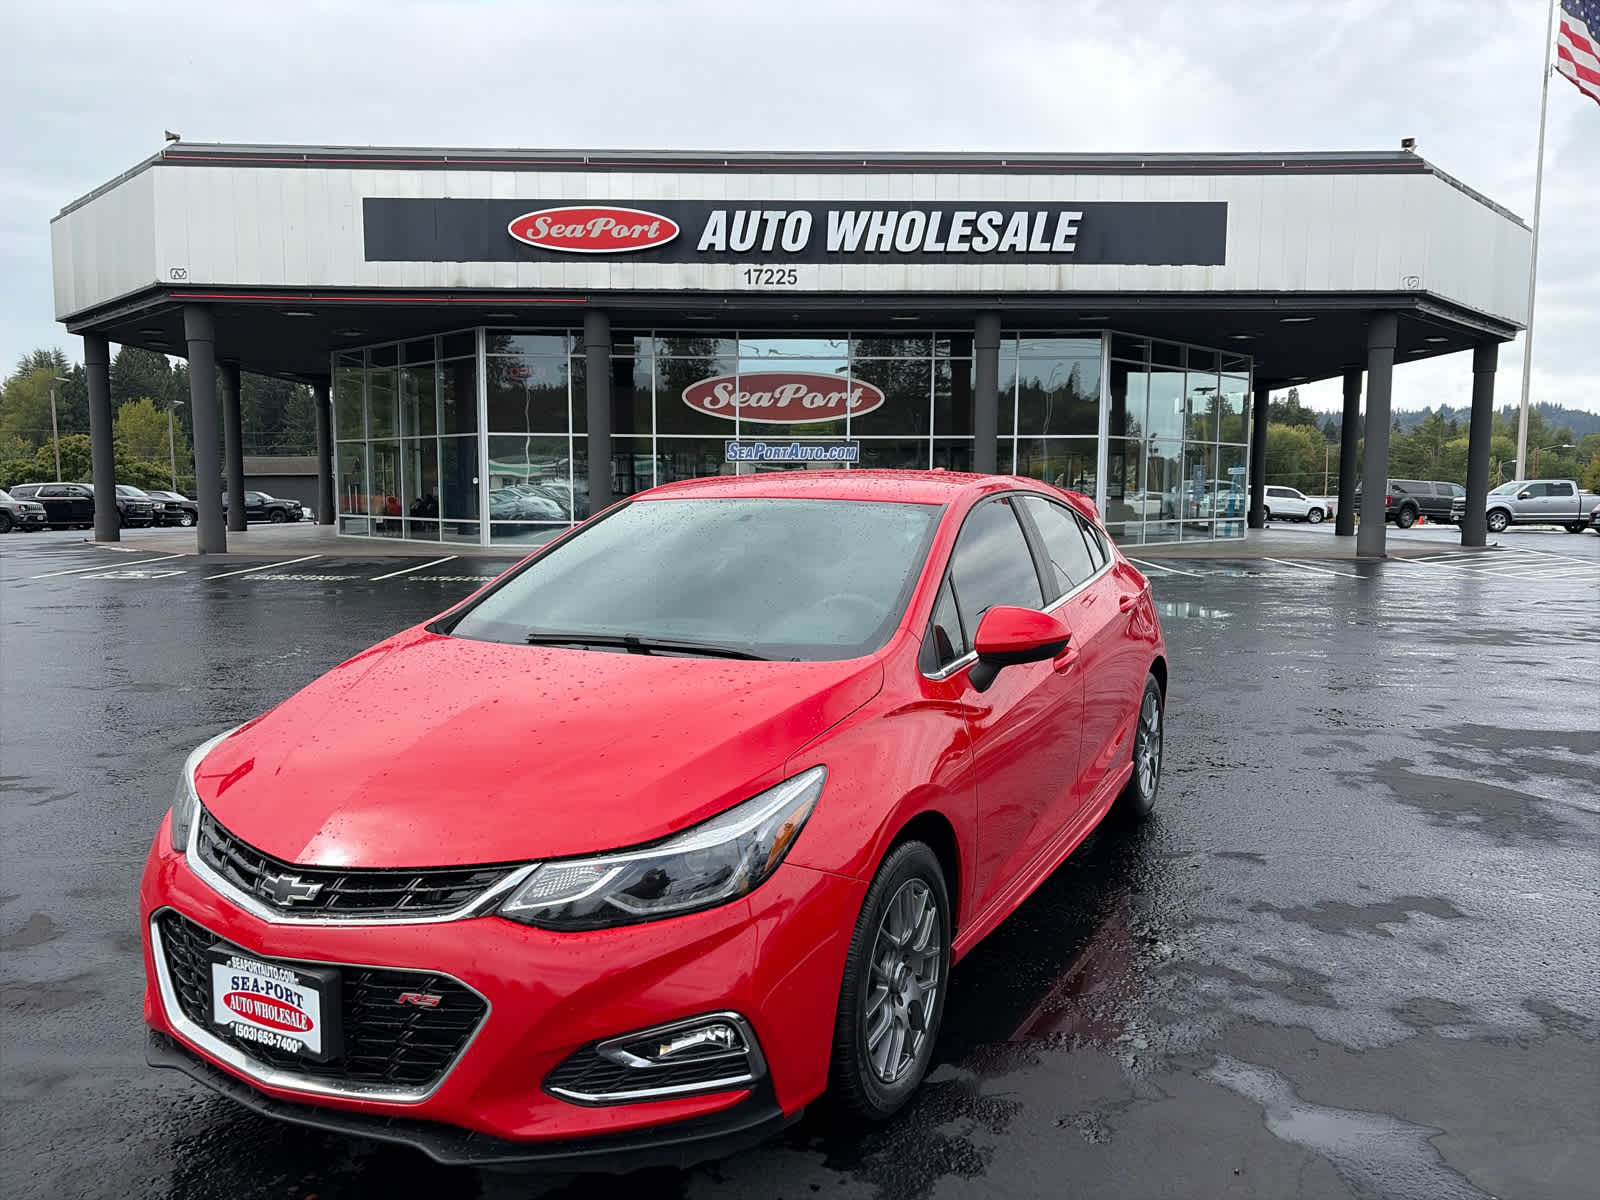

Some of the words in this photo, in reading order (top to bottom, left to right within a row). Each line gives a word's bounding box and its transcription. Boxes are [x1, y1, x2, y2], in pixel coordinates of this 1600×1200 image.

[526, 216, 661, 239] SeaPort
[697, 210, 813, 252] AUTO
[826, 210, 1083, 253] WHOLESALE
[743, 268, 798, 285] 17225
[703, 382, 864, 409] SeaPort
[231, 956, 297, 985] SEAPORTAUTO.COM
[231, 975, 304, 1009] SEA-PORT
[230, 994, 253, 1014] AUTO
[253, 1000, 308, 1030] WHOLESALE
